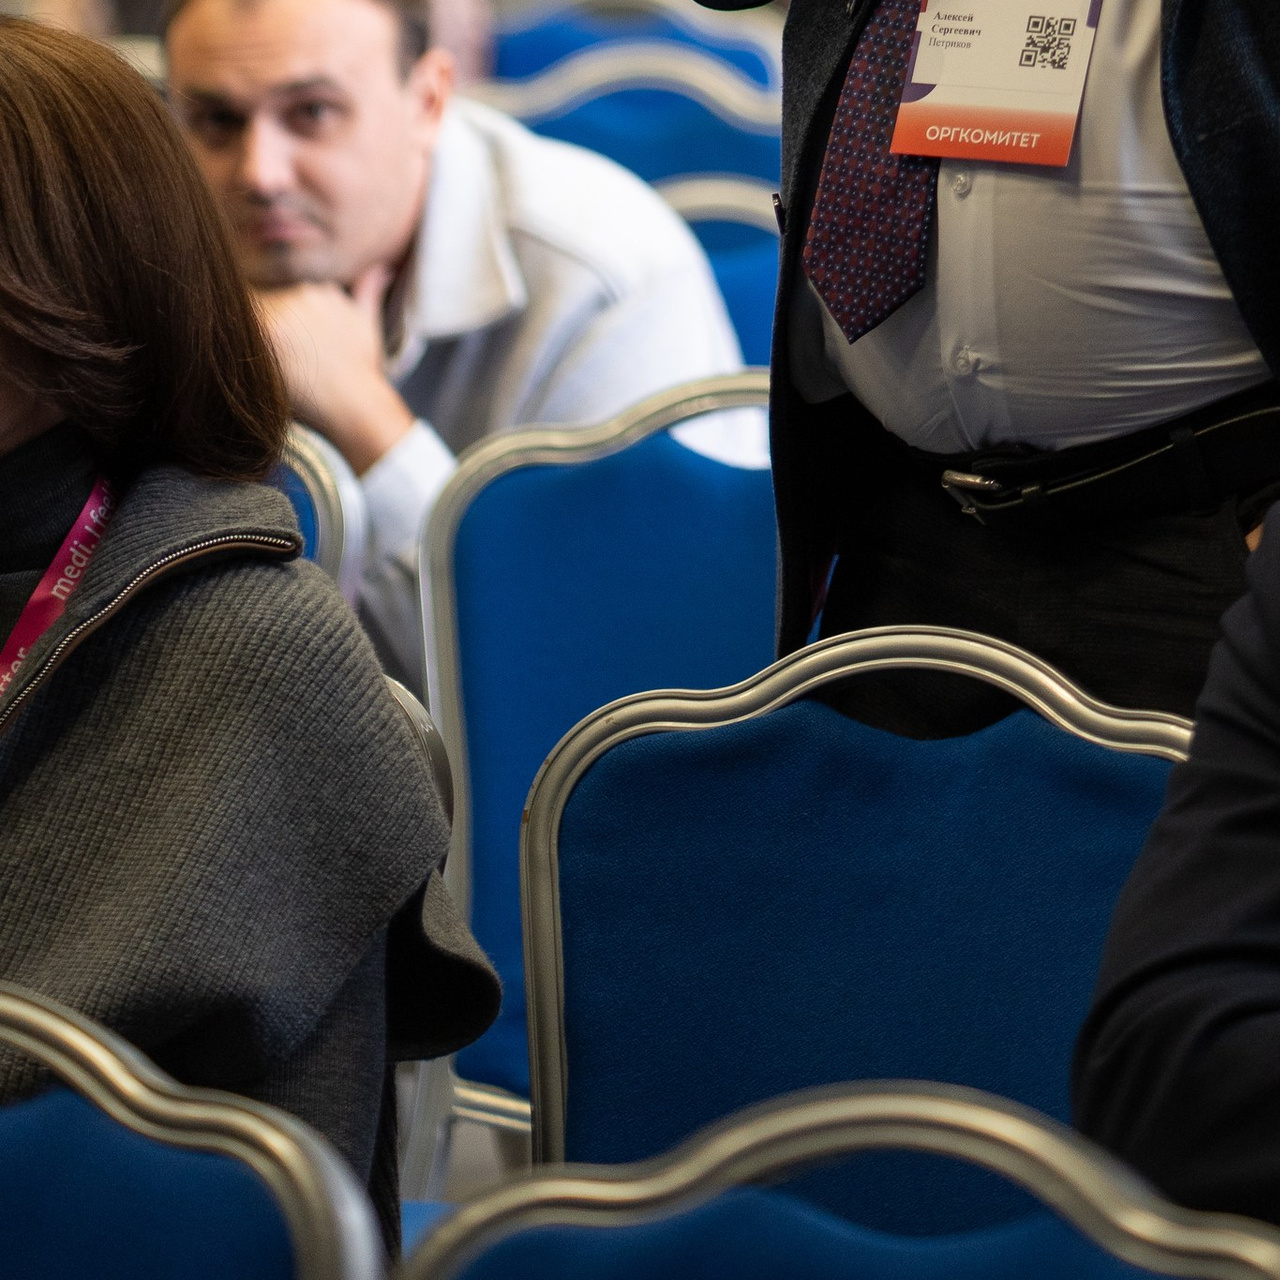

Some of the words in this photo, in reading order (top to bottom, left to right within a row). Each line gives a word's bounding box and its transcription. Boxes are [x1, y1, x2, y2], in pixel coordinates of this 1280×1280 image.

[933, 11, 975, 22] Алексей
[931, 24, 982, 36] Сергеевич
[928, 37, 972, 49] Петриков
[925, 125, 1041, 148] ОРГКОМИТЕТ
[51, 540, 96, 600] medi.
